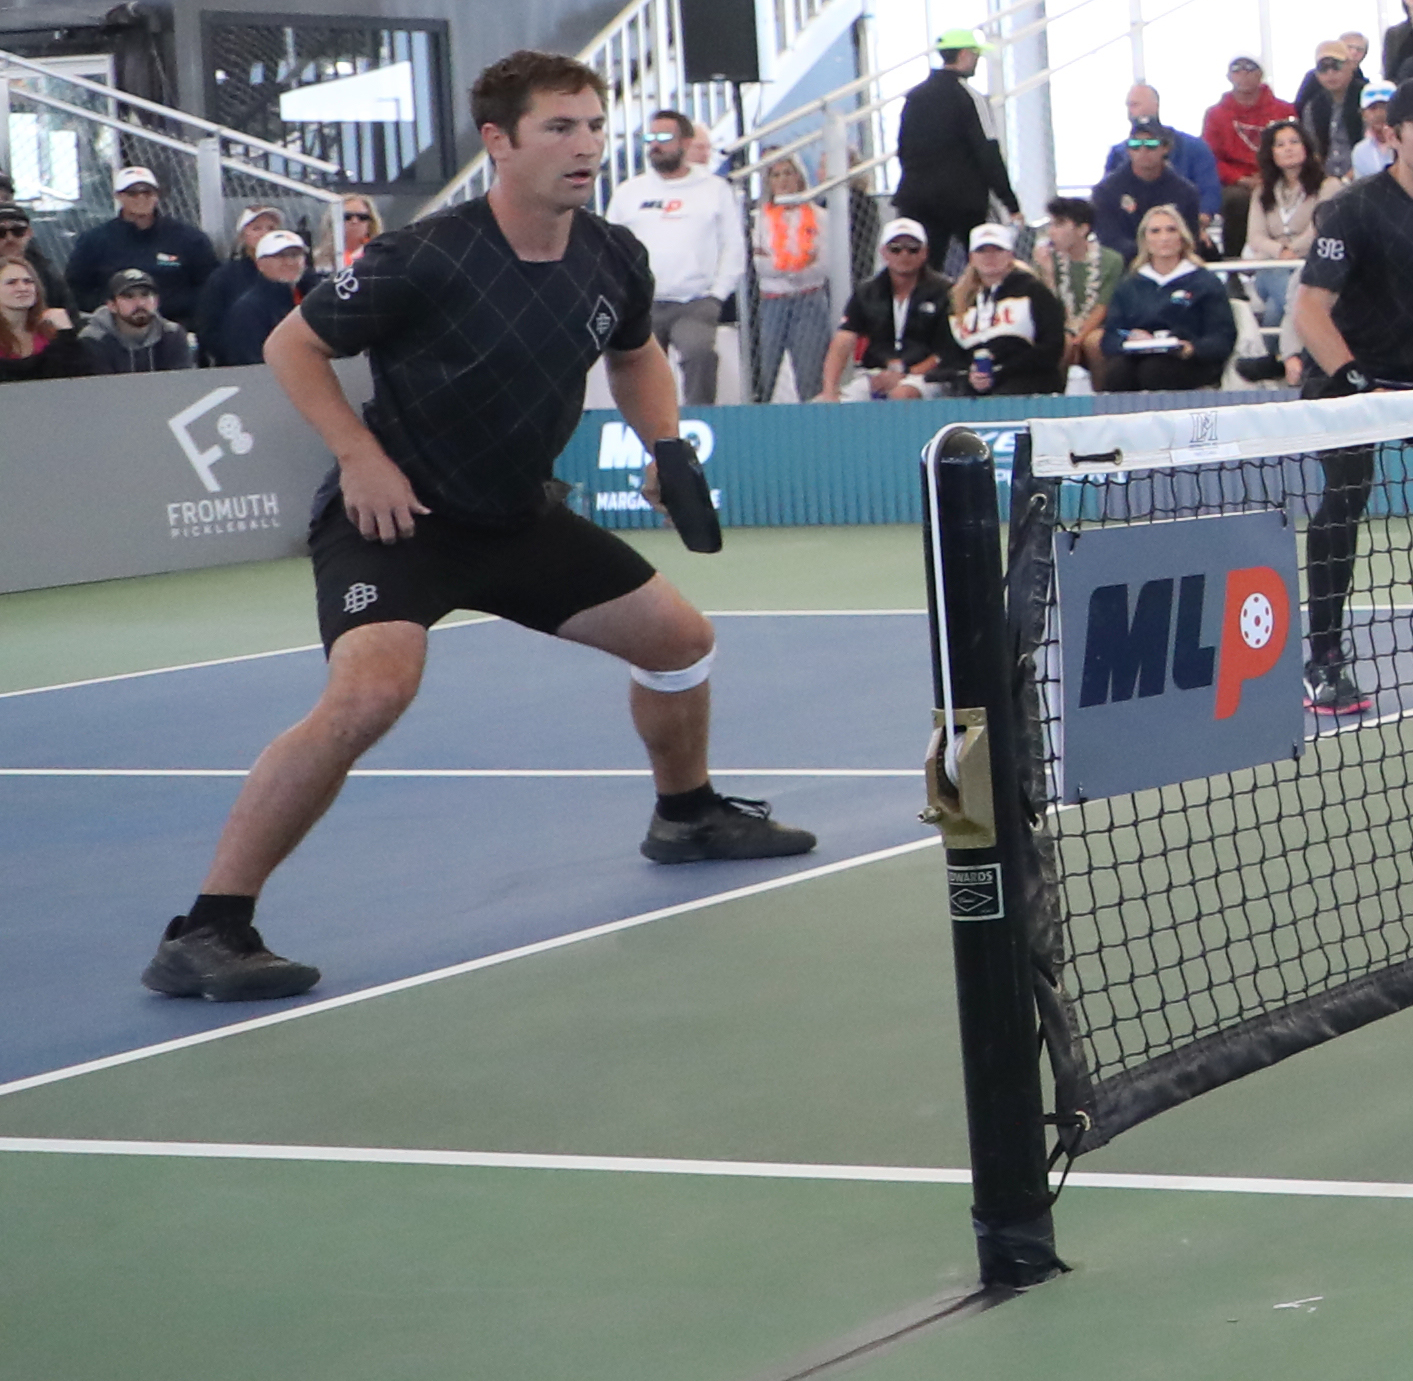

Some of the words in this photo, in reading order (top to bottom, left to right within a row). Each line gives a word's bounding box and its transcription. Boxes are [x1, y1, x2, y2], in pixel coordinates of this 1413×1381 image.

[167, 493, 279, 526] FROMUTH
[171, 518, 281, 538] PICKLEBALL
[1079, 565, 1291, 721] MLP
